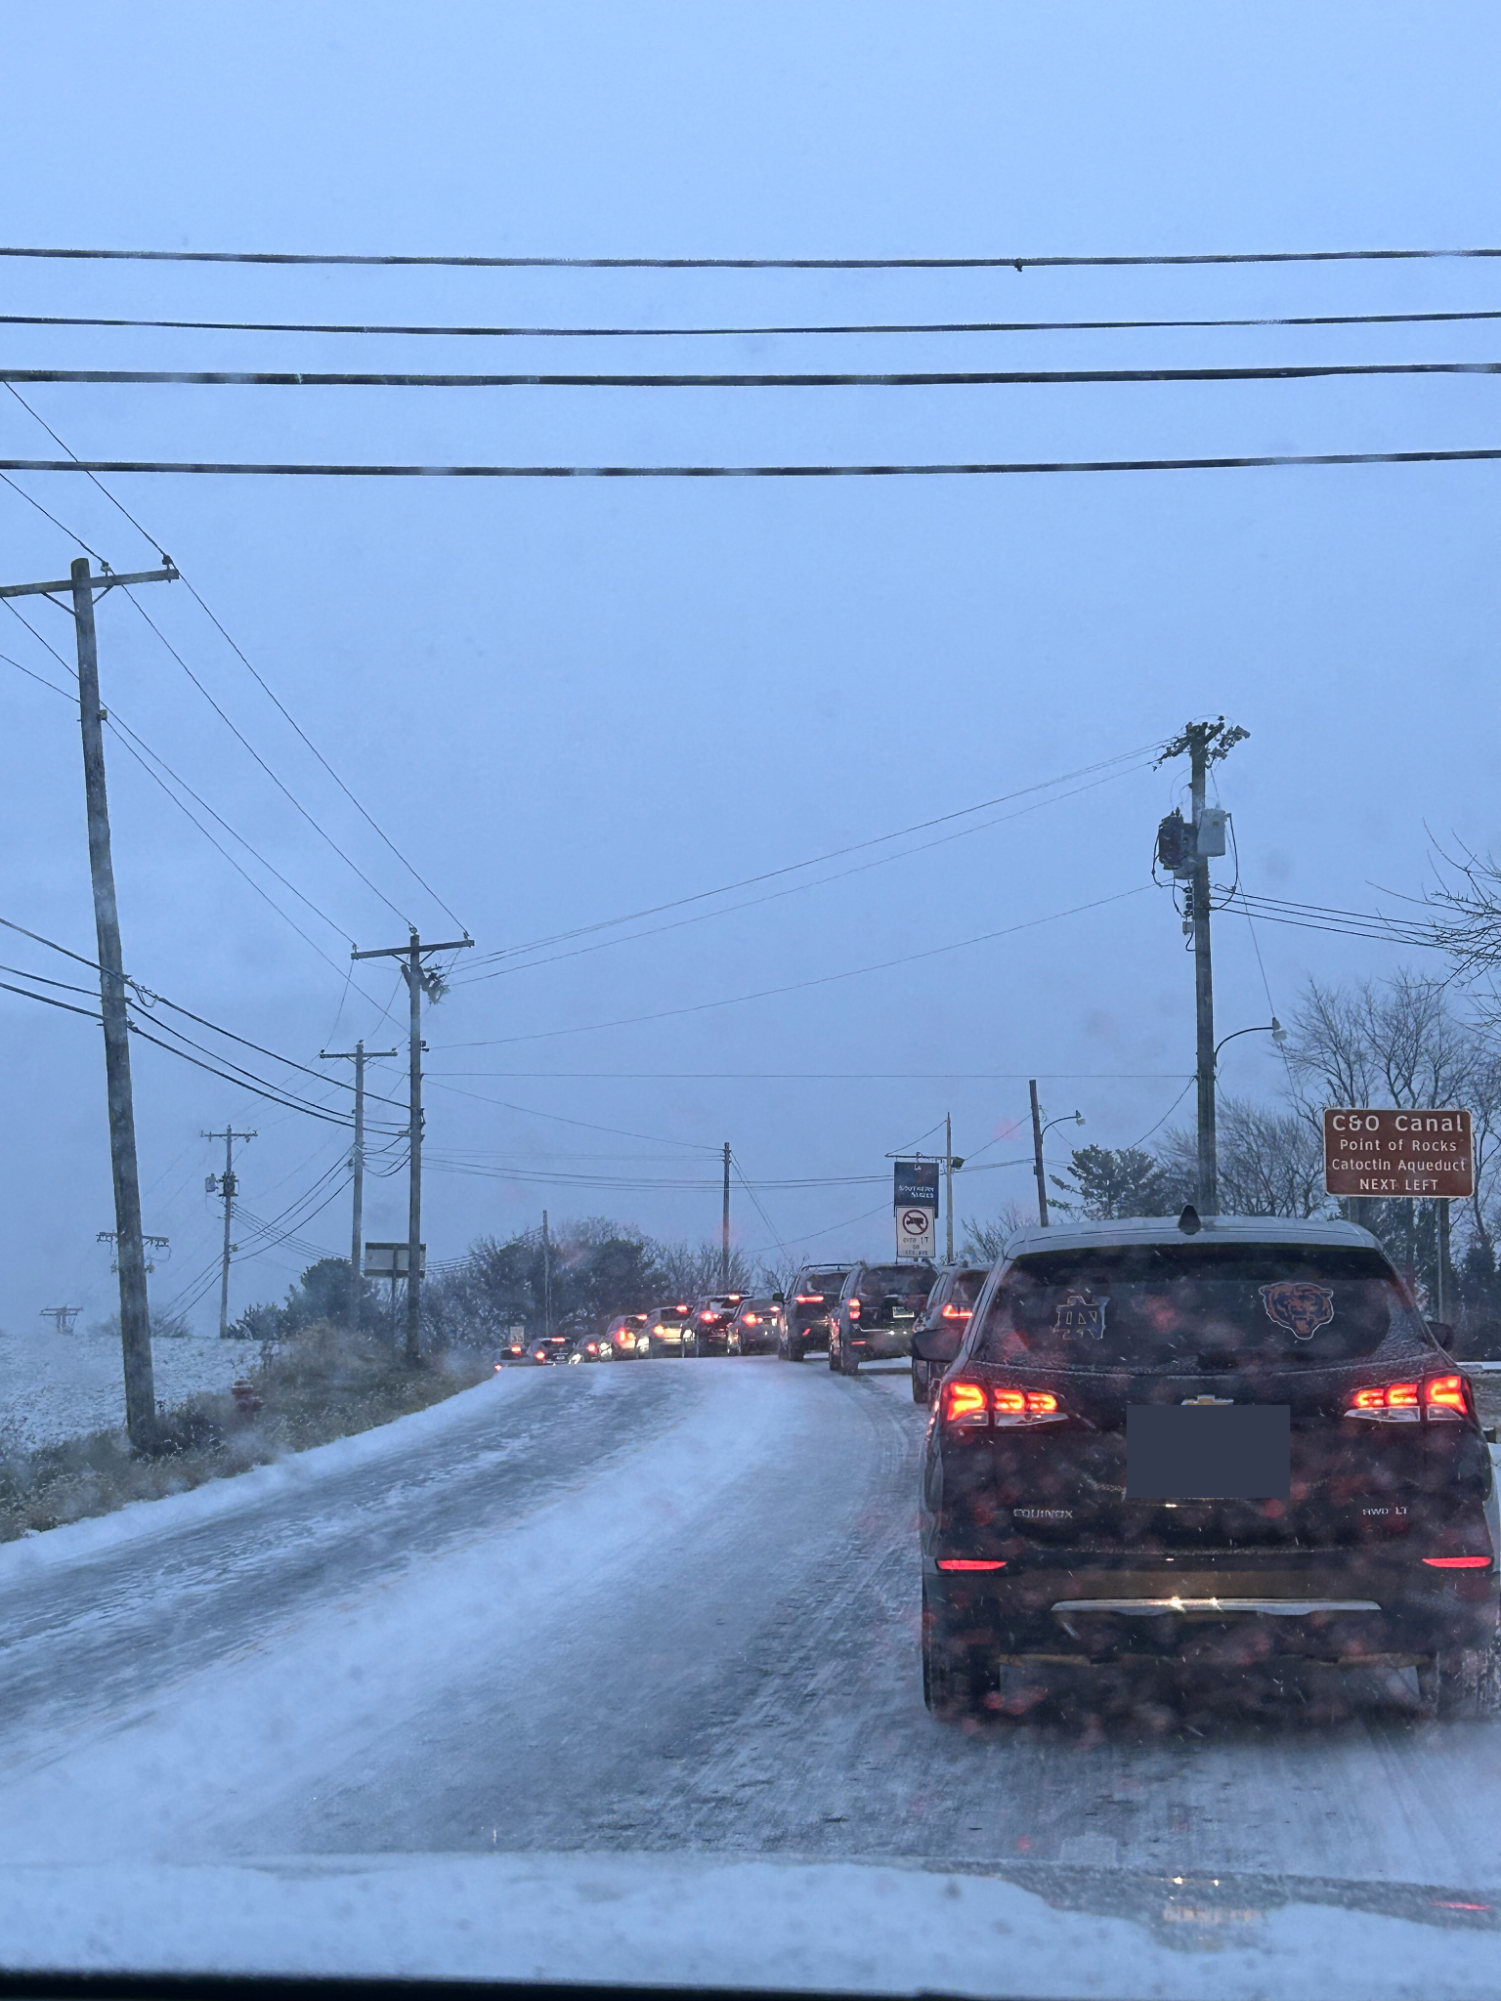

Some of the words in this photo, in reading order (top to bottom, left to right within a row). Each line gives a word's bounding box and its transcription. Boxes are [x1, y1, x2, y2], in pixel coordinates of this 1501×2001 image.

[1332, 1115, 1380, 1132] C&O
[1395, 1114, 1464, 1132] Canal
[1340, 1138, 1381, 1151] Point
[1388, 1139, 1404, 1151] of
[1412, 1140, 1457, 1152] Rocks
[1332, 1158, 1391, 1171] Catoctin
[1397, 1159, 1466, 1173] Aqueduct
[1359, 1178, 1397, 1190] NEXT
[1405, 1179, 1439, 1191] LEFT
[1013, 1508, 1073, 1519] EQUINOX
[1395, 1506, 1409, 1515] LT
